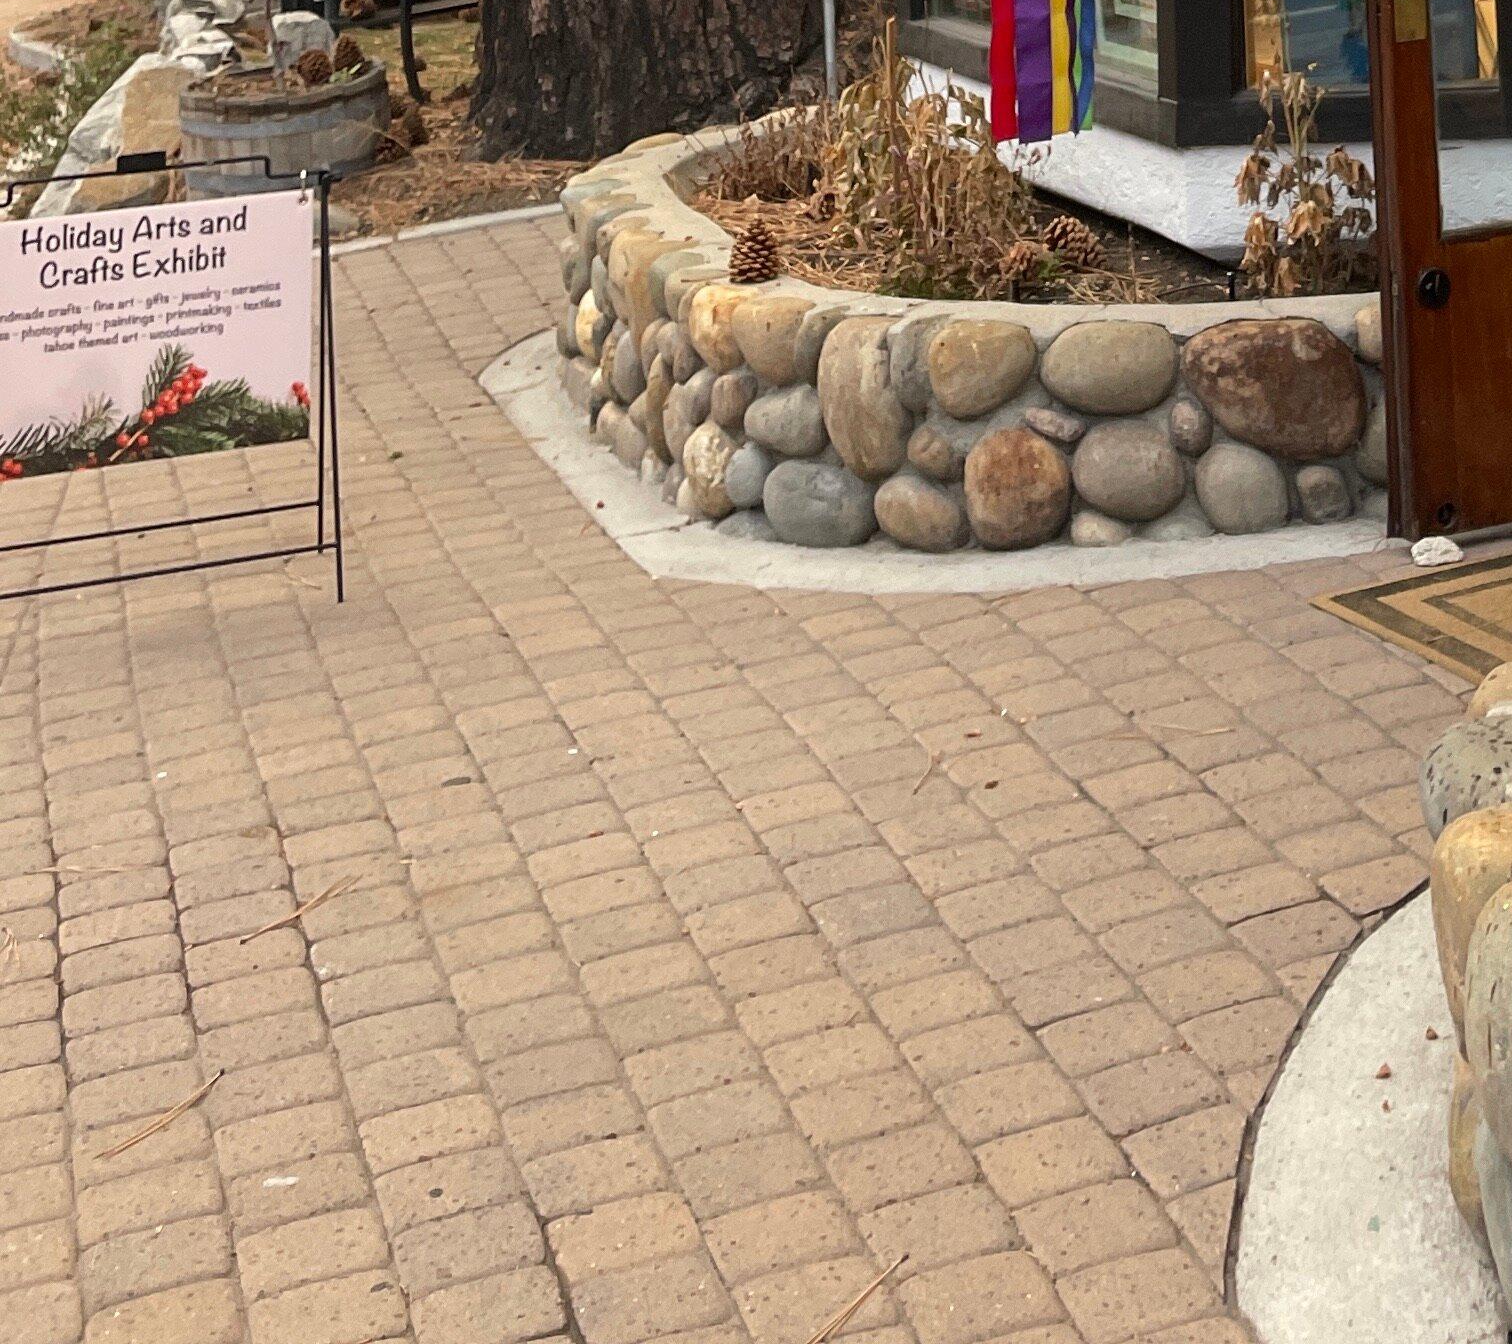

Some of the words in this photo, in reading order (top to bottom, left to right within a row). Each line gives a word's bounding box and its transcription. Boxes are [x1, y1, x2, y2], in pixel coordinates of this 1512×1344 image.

[21, 221, 123, 255] Holiday
[132, 215, 191, 242] Arts
[200, 205, 248, 235] and
[40, 255, 124, 290] Crafts
[133, 244, 227, 278] Exhibit
[21, 318, 93, 342] photography
[103, 313, 155, 331] paintings
[165, 304, 232, 324] printmaking
[48, 303, 82, 318] crafts
[93, 300, 115, 313] fine
[117, 298, 135, 310] art
[145, 292, 169, 310] gifts
[44, 339, 75, 353] tahoe
[78, 336, 119, 349] themed
[122, 332, 138, 344] art
[149, 322, 224, 341] woodworking
